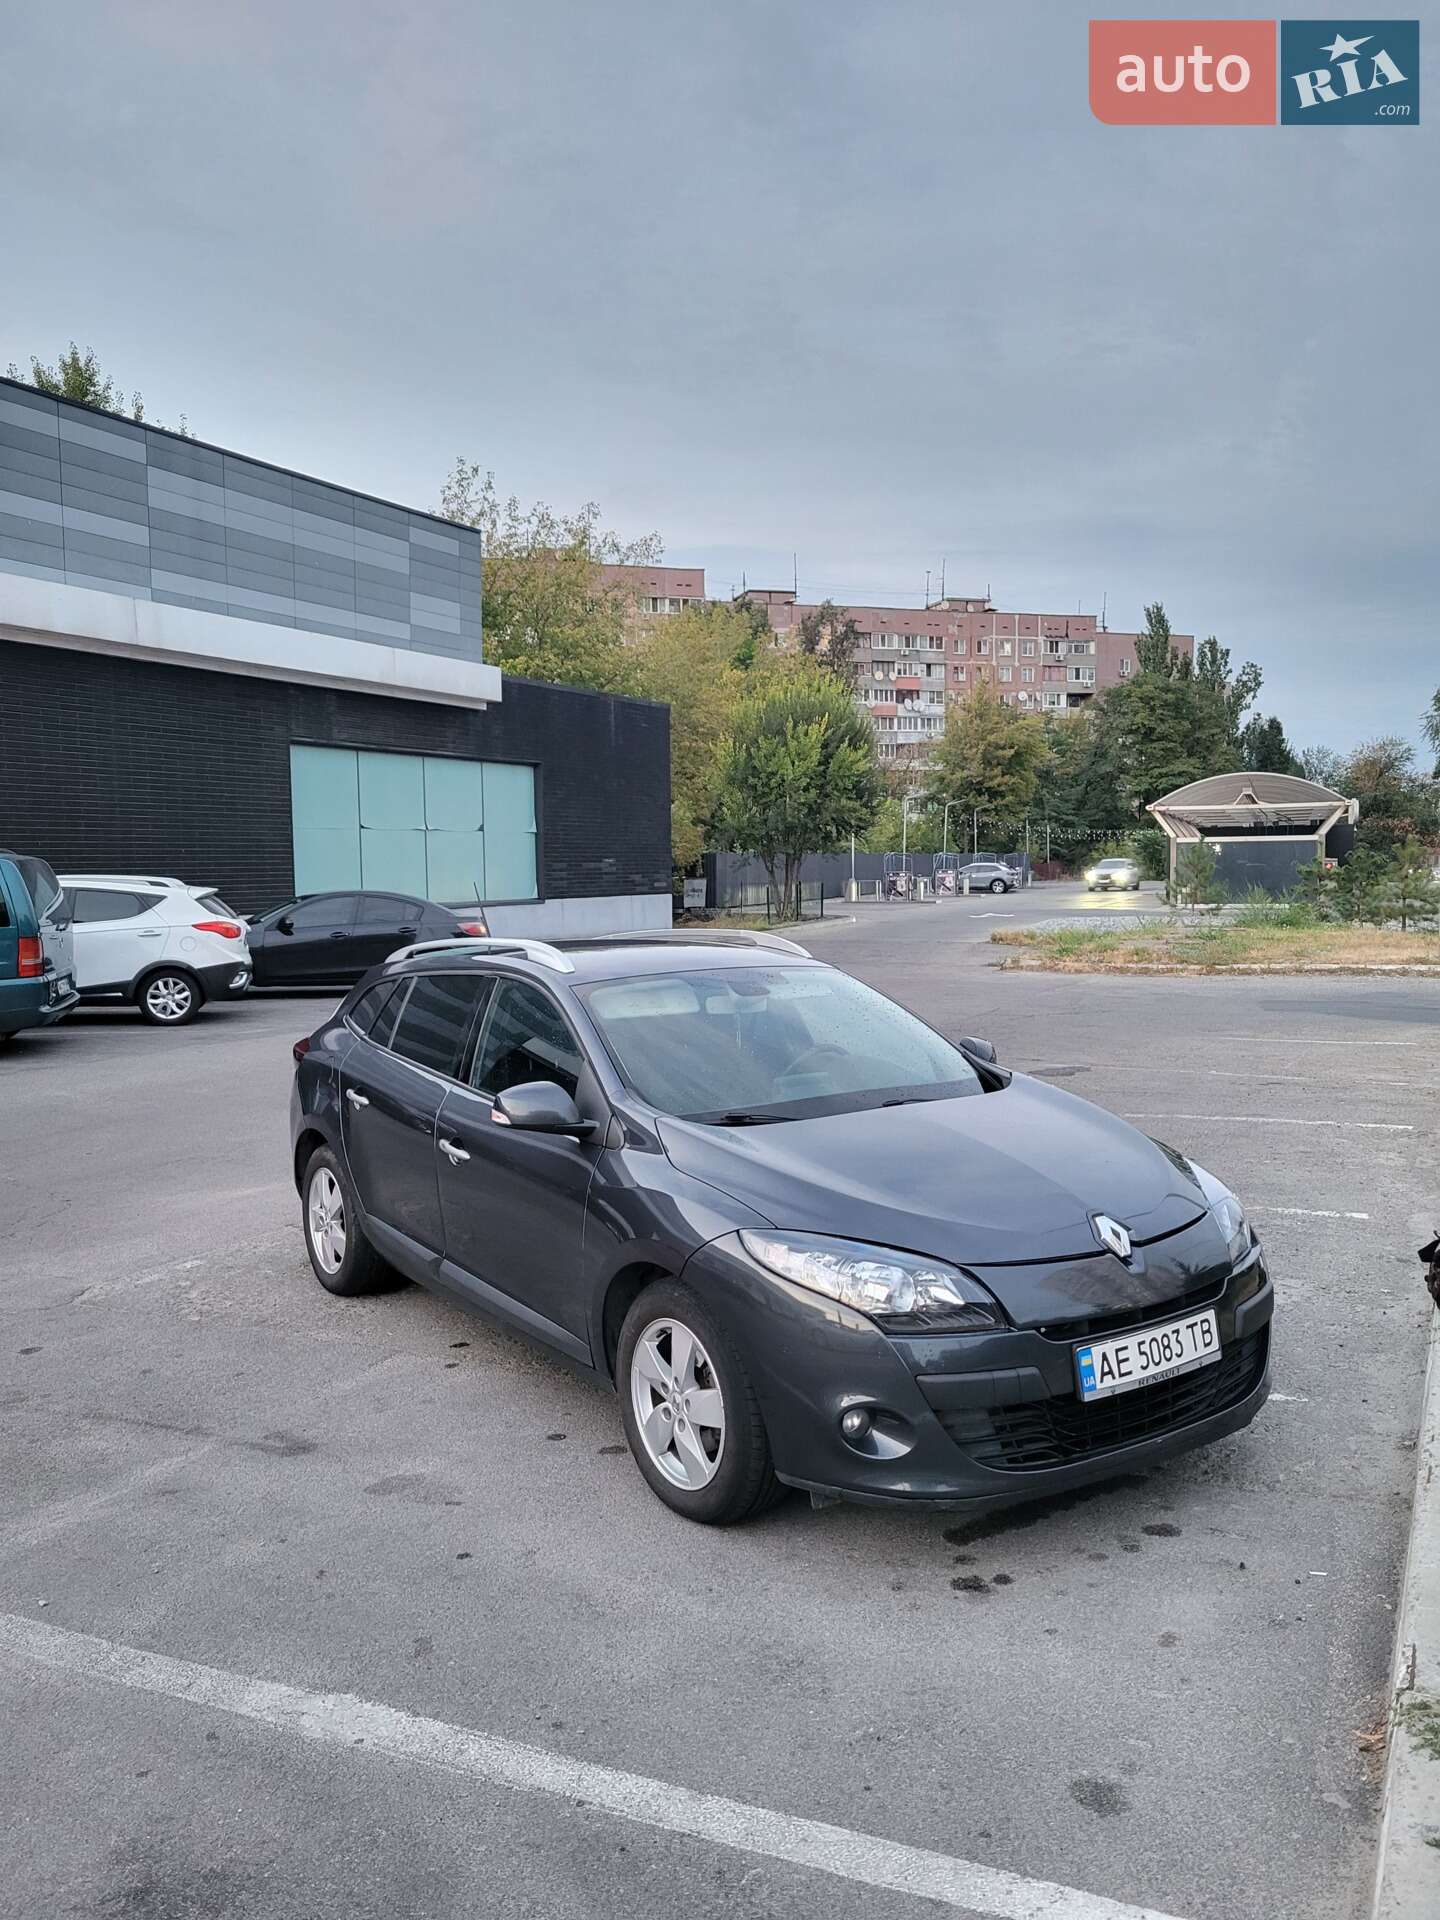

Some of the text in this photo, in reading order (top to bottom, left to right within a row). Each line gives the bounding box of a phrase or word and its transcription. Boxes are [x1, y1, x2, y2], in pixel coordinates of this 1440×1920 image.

[1099, 1317, 1214, 1384] AE 5083 TB
[1083, 1374, 1096, 1388] UA
[1138, 1367, 1180, 1387] RENAULT
